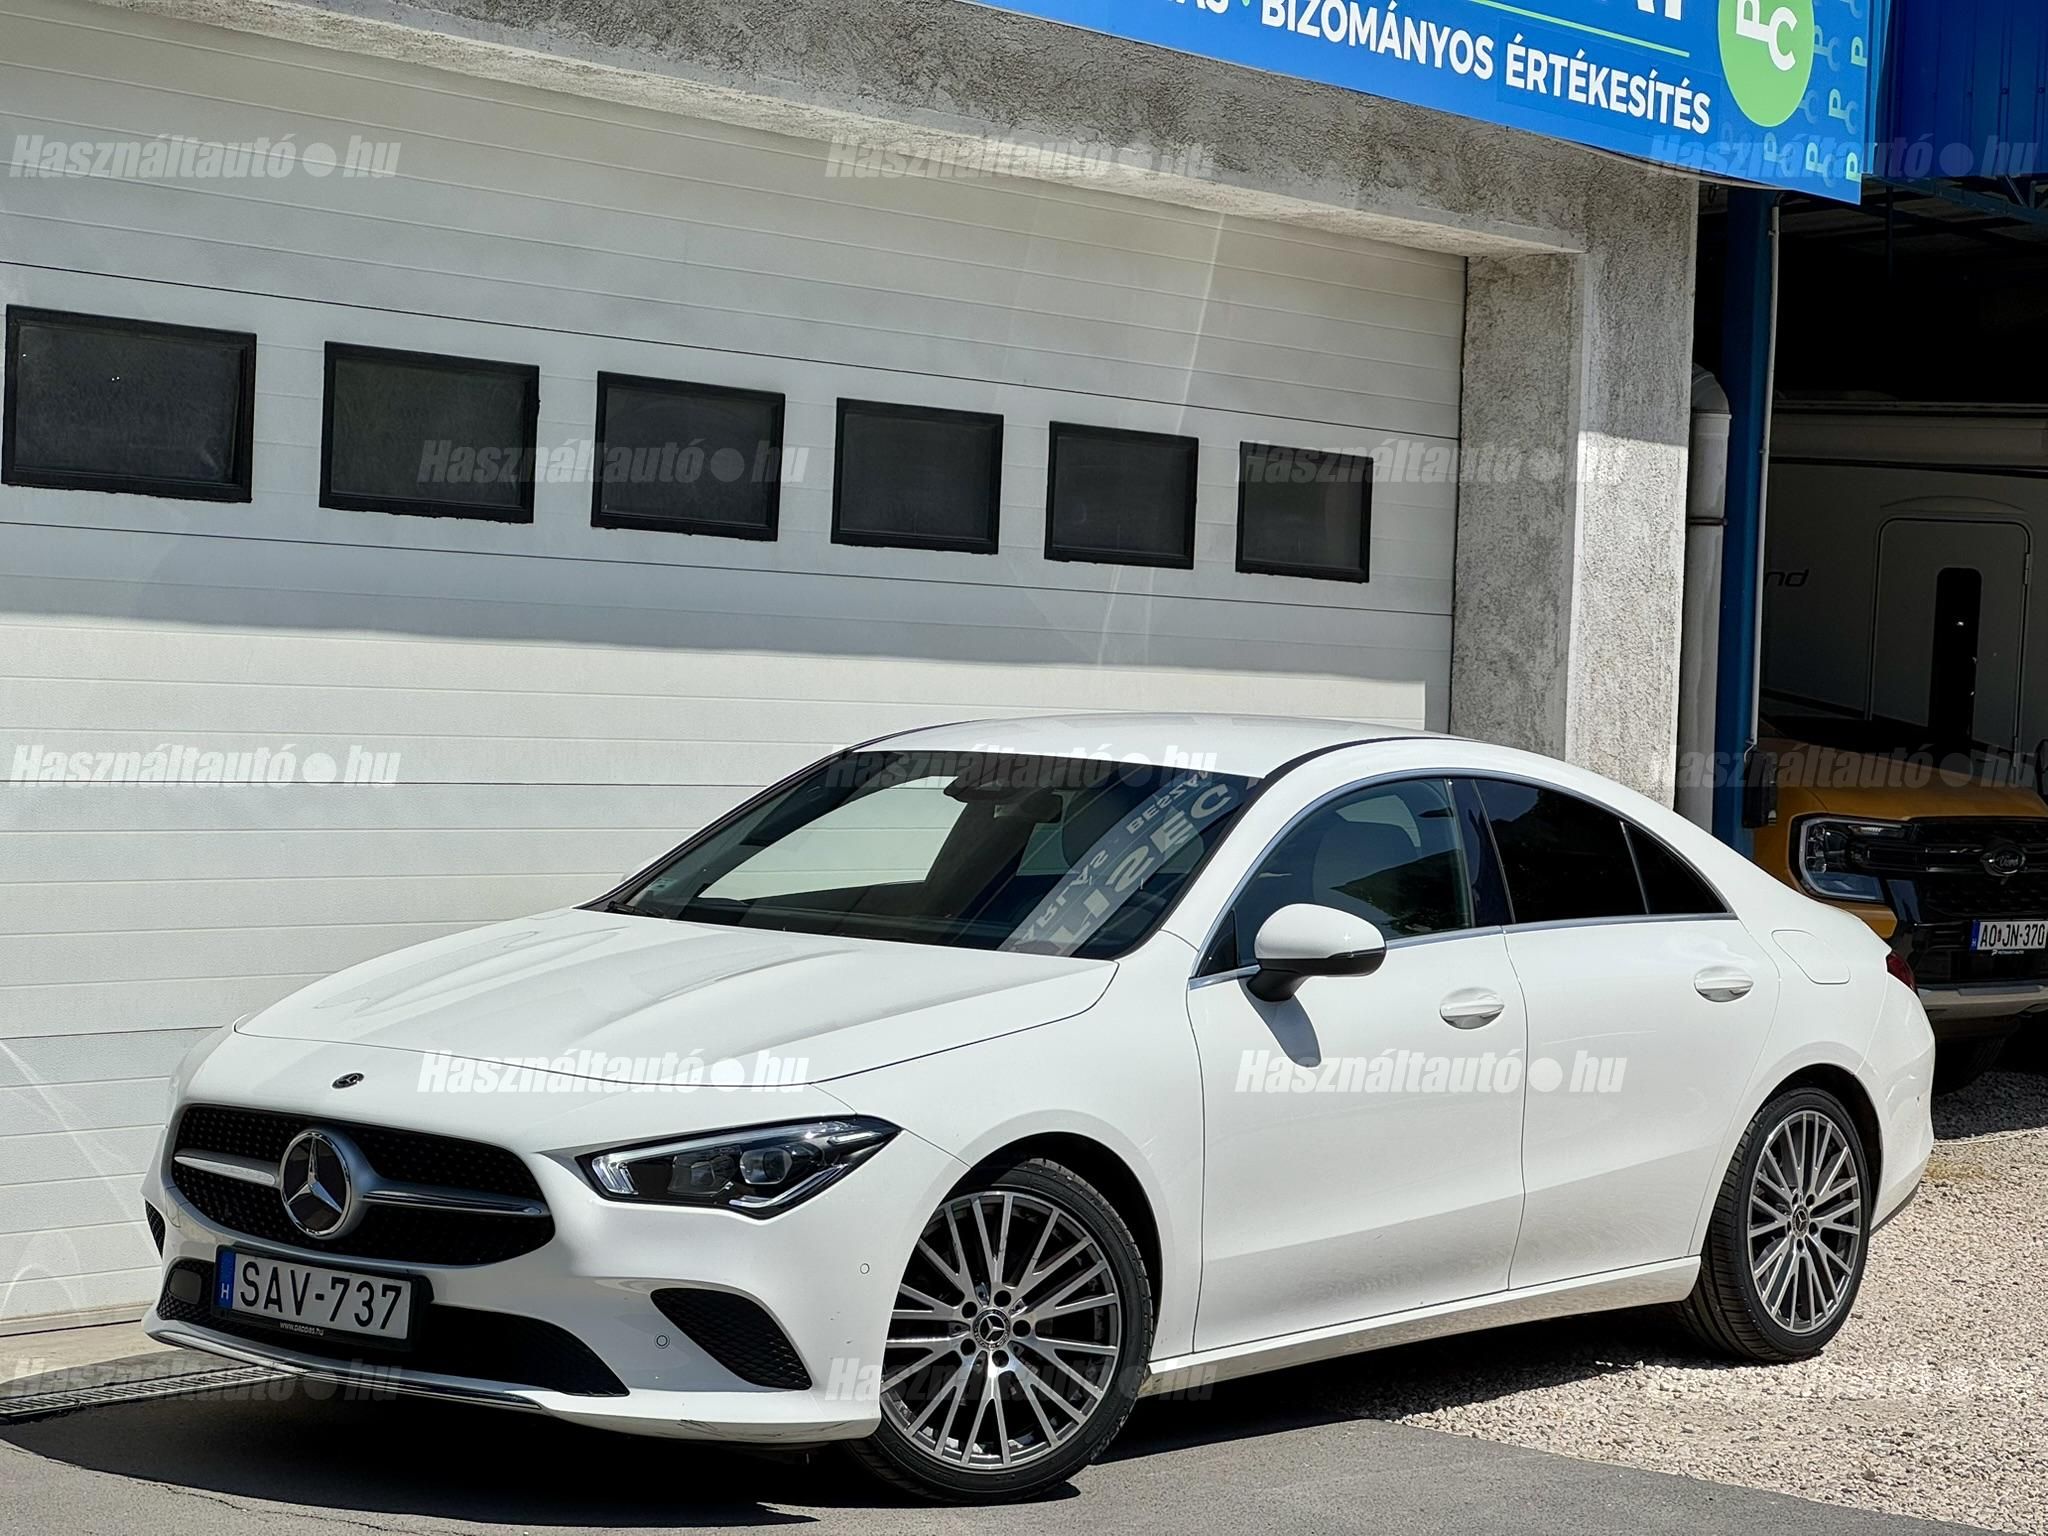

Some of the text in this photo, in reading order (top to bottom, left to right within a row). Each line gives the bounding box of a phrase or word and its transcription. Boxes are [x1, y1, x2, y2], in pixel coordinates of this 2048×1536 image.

[1261, 0, 1711, 134] BIZOMÁNYOS ÉRTÉKESÍTÉS
[240, 1260, 403, 1330] SAV-737
